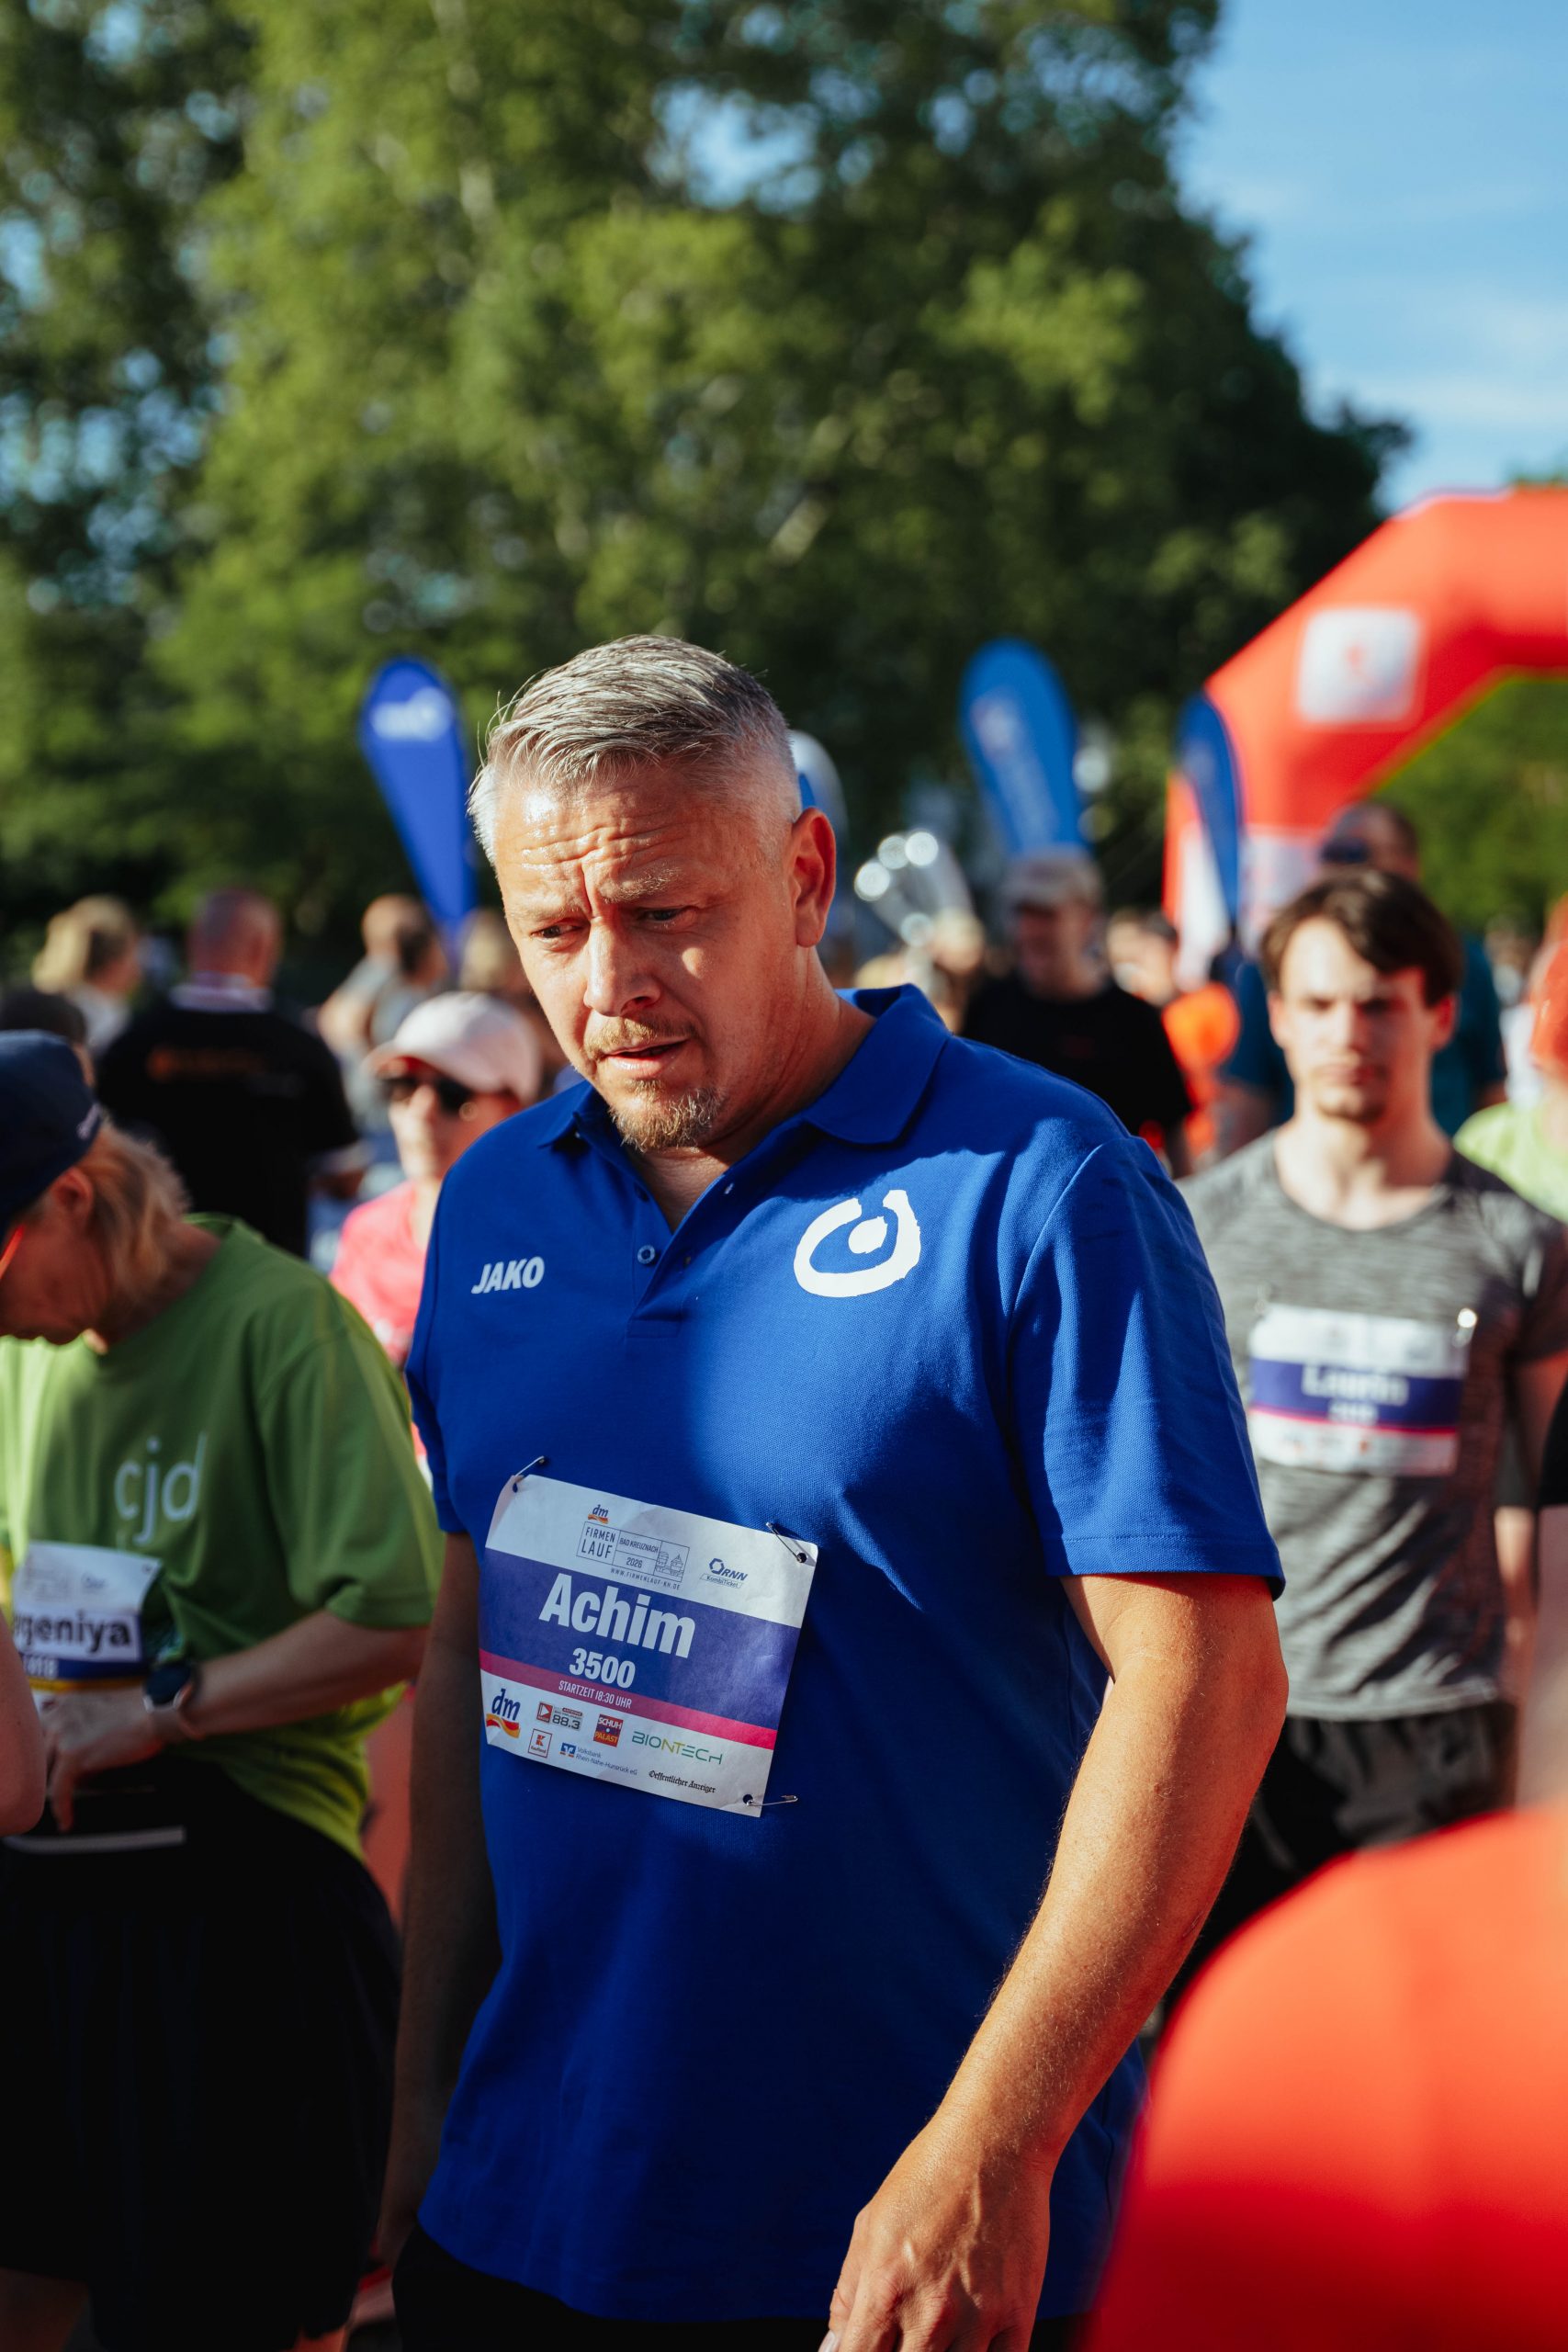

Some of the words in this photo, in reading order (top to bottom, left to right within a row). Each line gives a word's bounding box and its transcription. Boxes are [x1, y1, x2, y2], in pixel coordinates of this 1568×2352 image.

[471, 1256, 545, 1295] JAKO
[115, 1430, 207, 1544] cjd
[592, 1504, 608, 1517] dm
[585, 1527, 616, 1544] FIRMEN
[581, 1539, 613, 1559] LAUF
[619, 1537, 630, 1545] BAD
[630, 1540, 660, 1554] KREUZNACH
[626, 1556, 643, 1568] 2026
[538, 1572, 695, 1658] Achim
[569, 1647, 636, 1689] 3500
[558, 1680, 595, 1699] STARTZEIT
[595, 1690, 615, 1704] 18:30
[615, 1695, 632, 1709] UHR
[491, 1688, 521, 1721] dm
[552, 1714, 581, 1730] 88.3
[598, 1717, 623, 1729] SCHUH
[594, 1731, 618, 1743] PALAST
[578, 1747, 602, 1758] Volksbank
[631, 1731, 723, 1765] BIONTECH
[688, 1781, 716, 1793] Anzeiger
